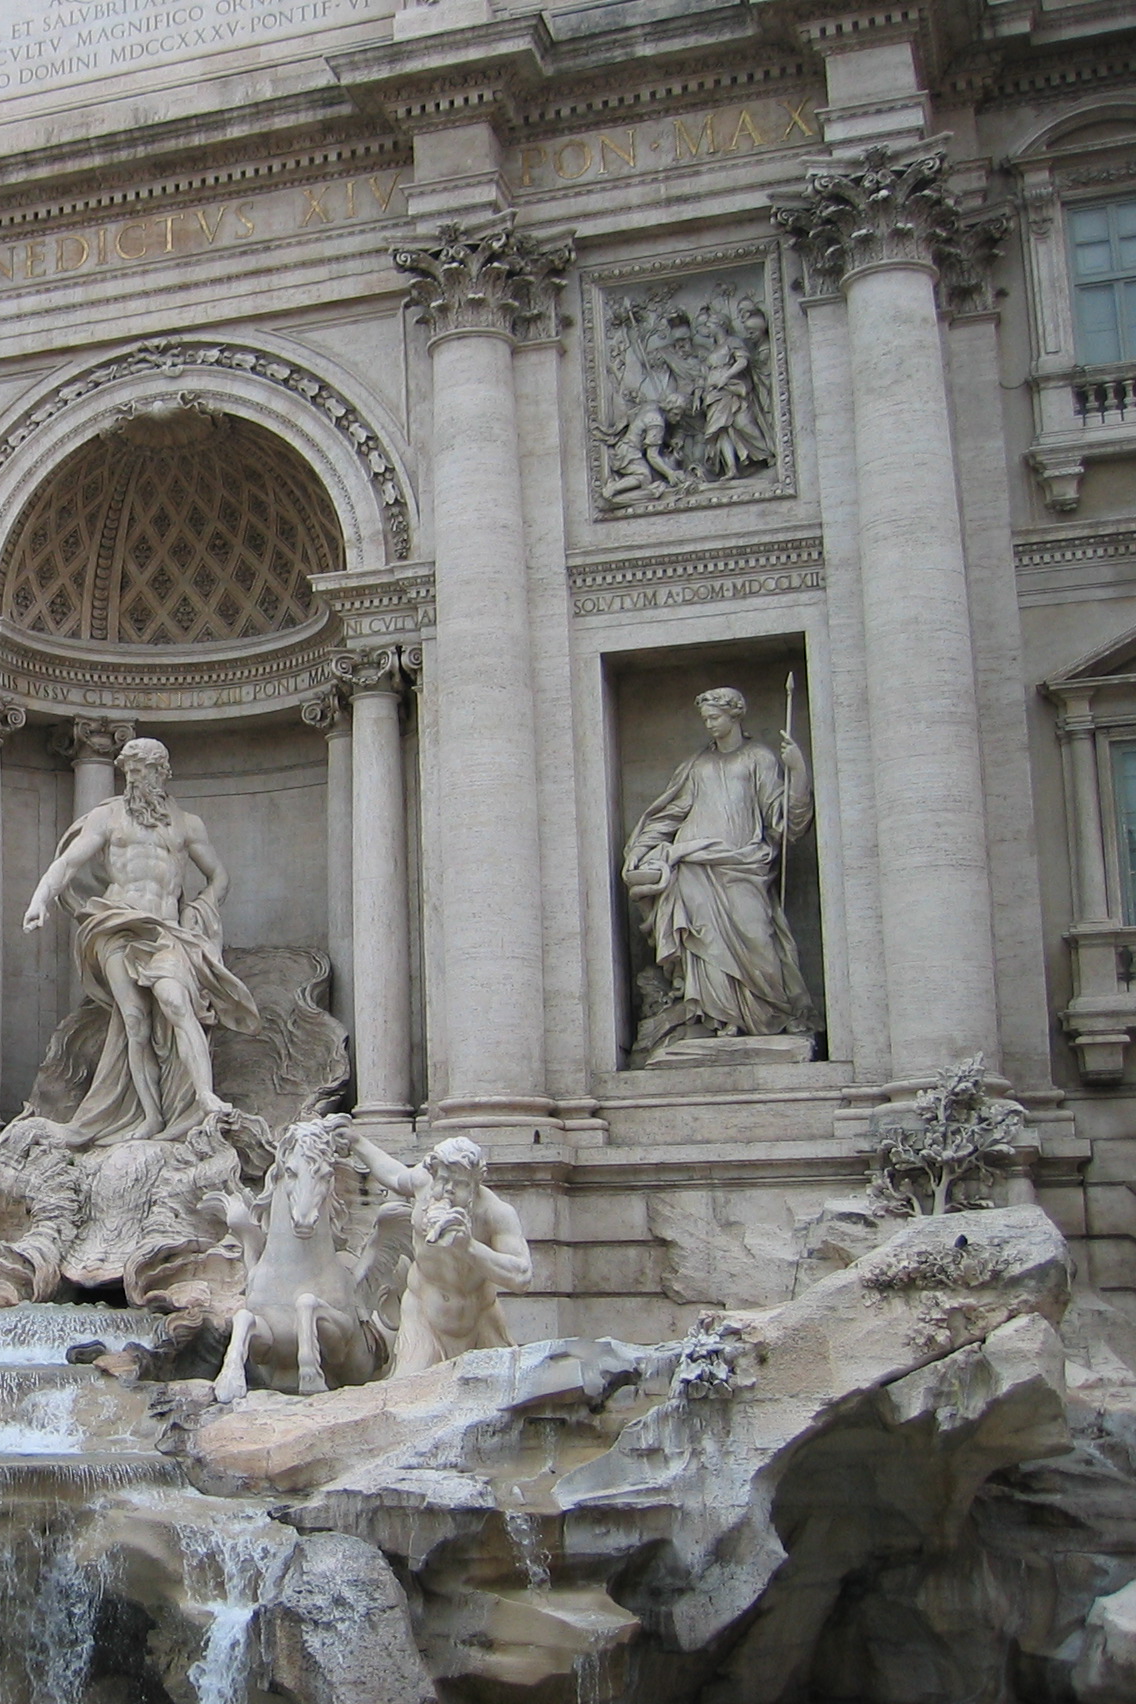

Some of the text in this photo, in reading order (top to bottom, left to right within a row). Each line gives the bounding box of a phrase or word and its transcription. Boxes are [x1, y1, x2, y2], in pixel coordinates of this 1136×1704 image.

[11, 20, 35, 40] ET
[76, 6, 204, 48] MAGNIFICO
[19, 53, 98, 85] DOMINI
[520, 100, 814, 186] PON MAX
[298, 172, 402, 229] XIV
[573, 590, 658, 616] SOLVTVM
